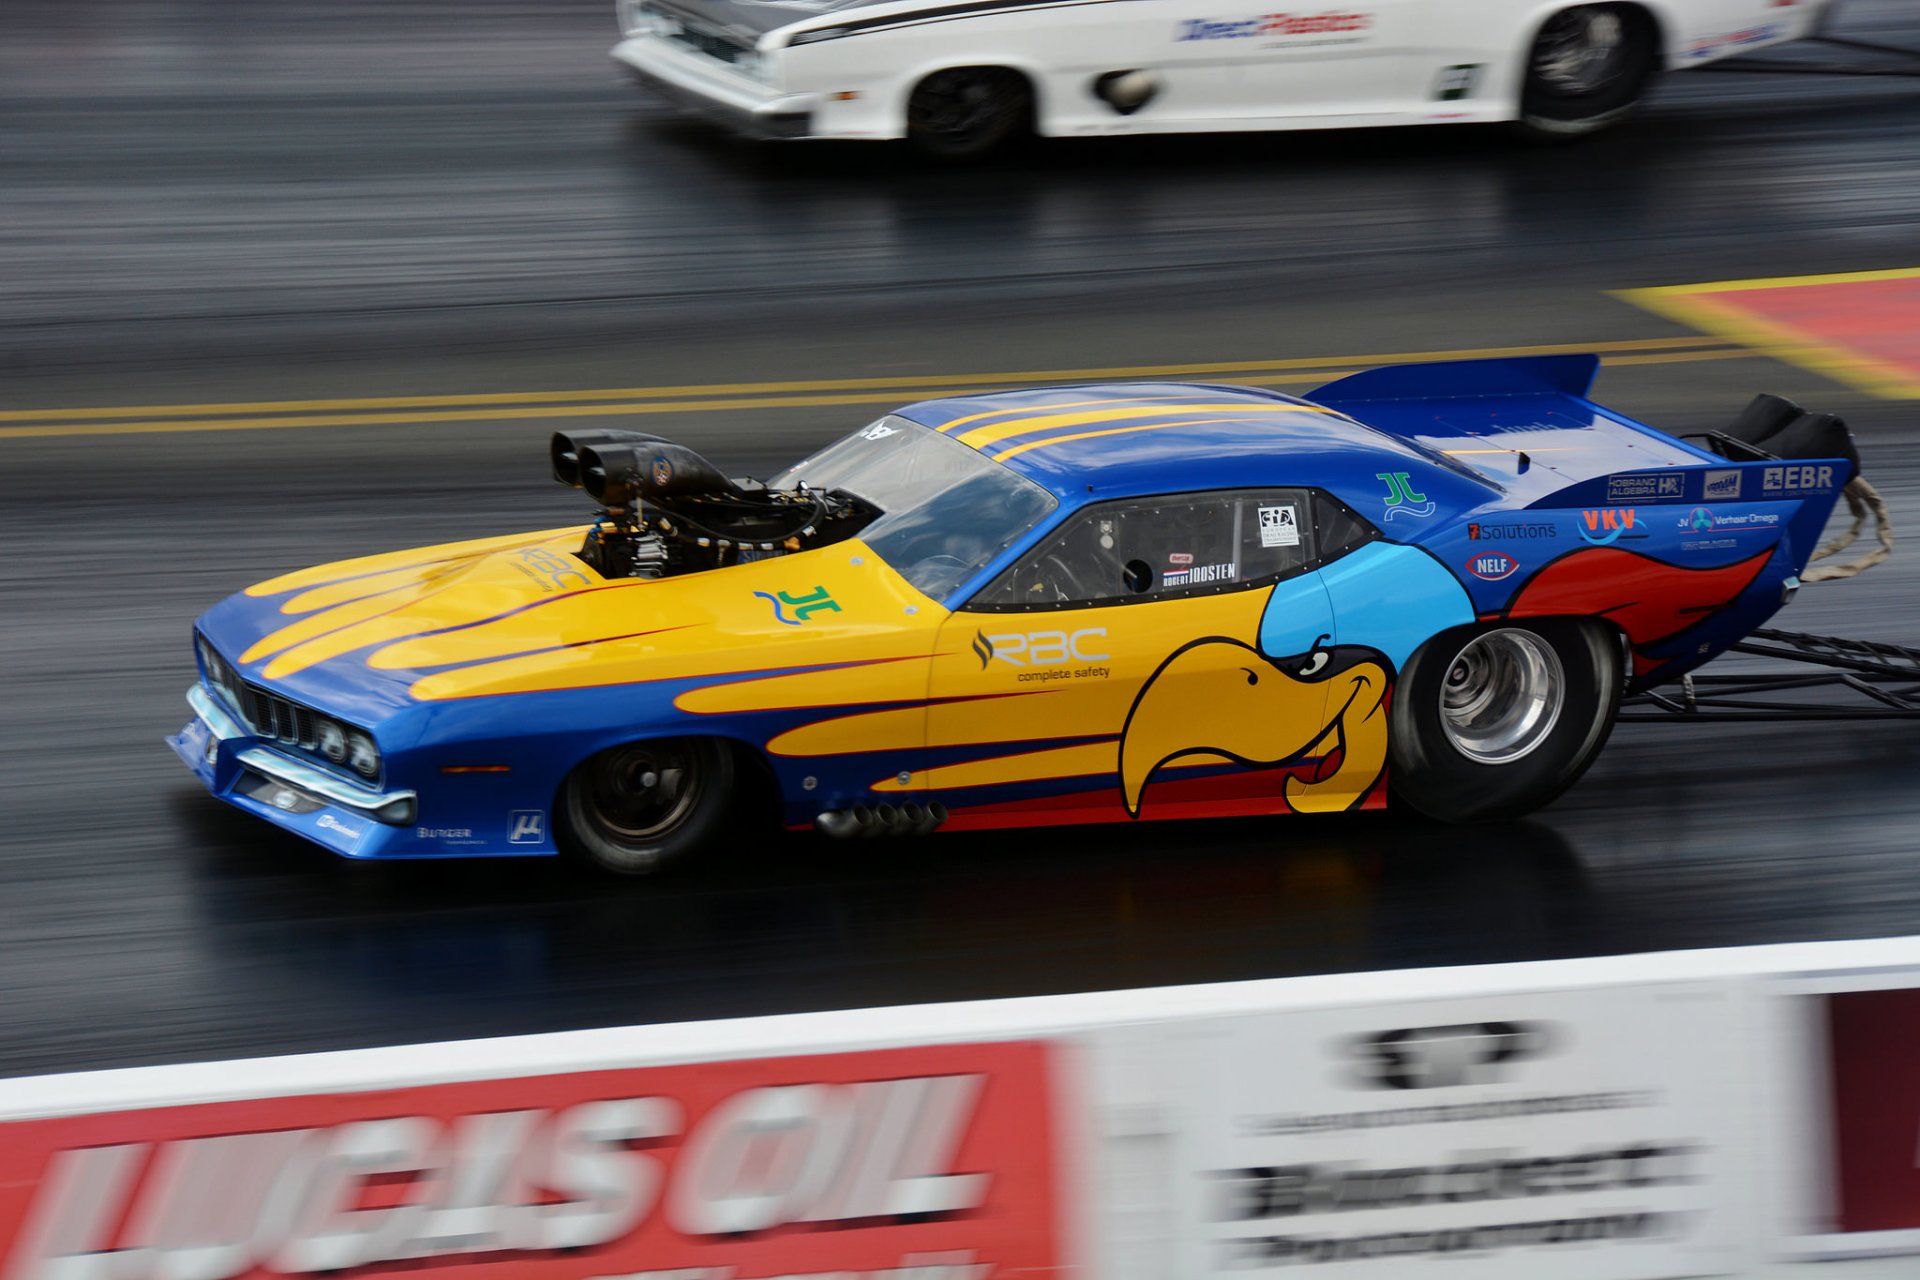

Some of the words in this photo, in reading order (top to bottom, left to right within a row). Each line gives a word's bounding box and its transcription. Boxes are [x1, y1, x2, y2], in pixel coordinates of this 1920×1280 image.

[1784, 465, 1833, 489] EBR
[1610, 486, 1657, 496] ALGEBRA
[1583, 509, 1635, 531] VKV
[1749, 513, 1779, 524] Omega
[1163, 574, 1189, 587] ROBERT
[1188, 562, 1236, 584] JOOSTEN
[1477, 558, 1508, 574] NELF
[988, 627, 1111, 667] RBC
[1018, 668, 1072, 683] complete
[1074, 666, 1111, 679] safety
